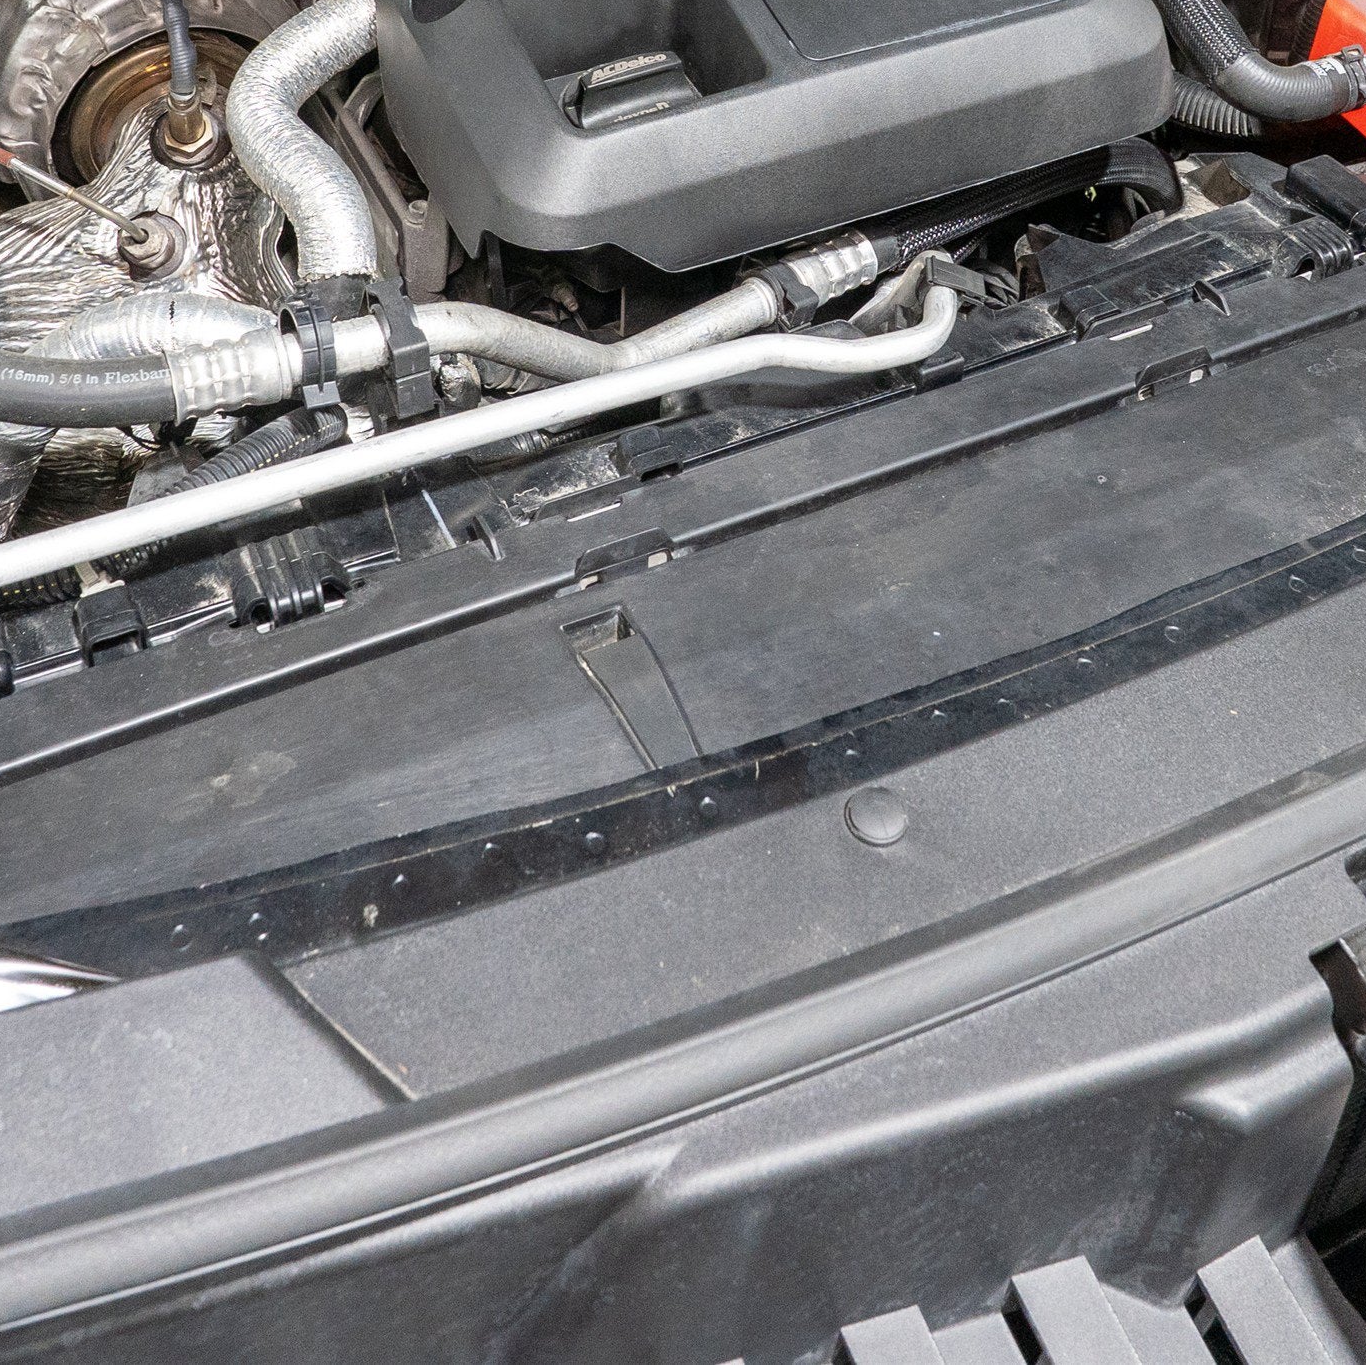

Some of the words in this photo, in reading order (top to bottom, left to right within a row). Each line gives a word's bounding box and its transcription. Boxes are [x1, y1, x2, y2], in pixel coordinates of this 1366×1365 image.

[591, 53, 667, 84] ACDelco
[1, 367, 54, 385] (16mm)
[59, 373, 82, 384] 5/8
